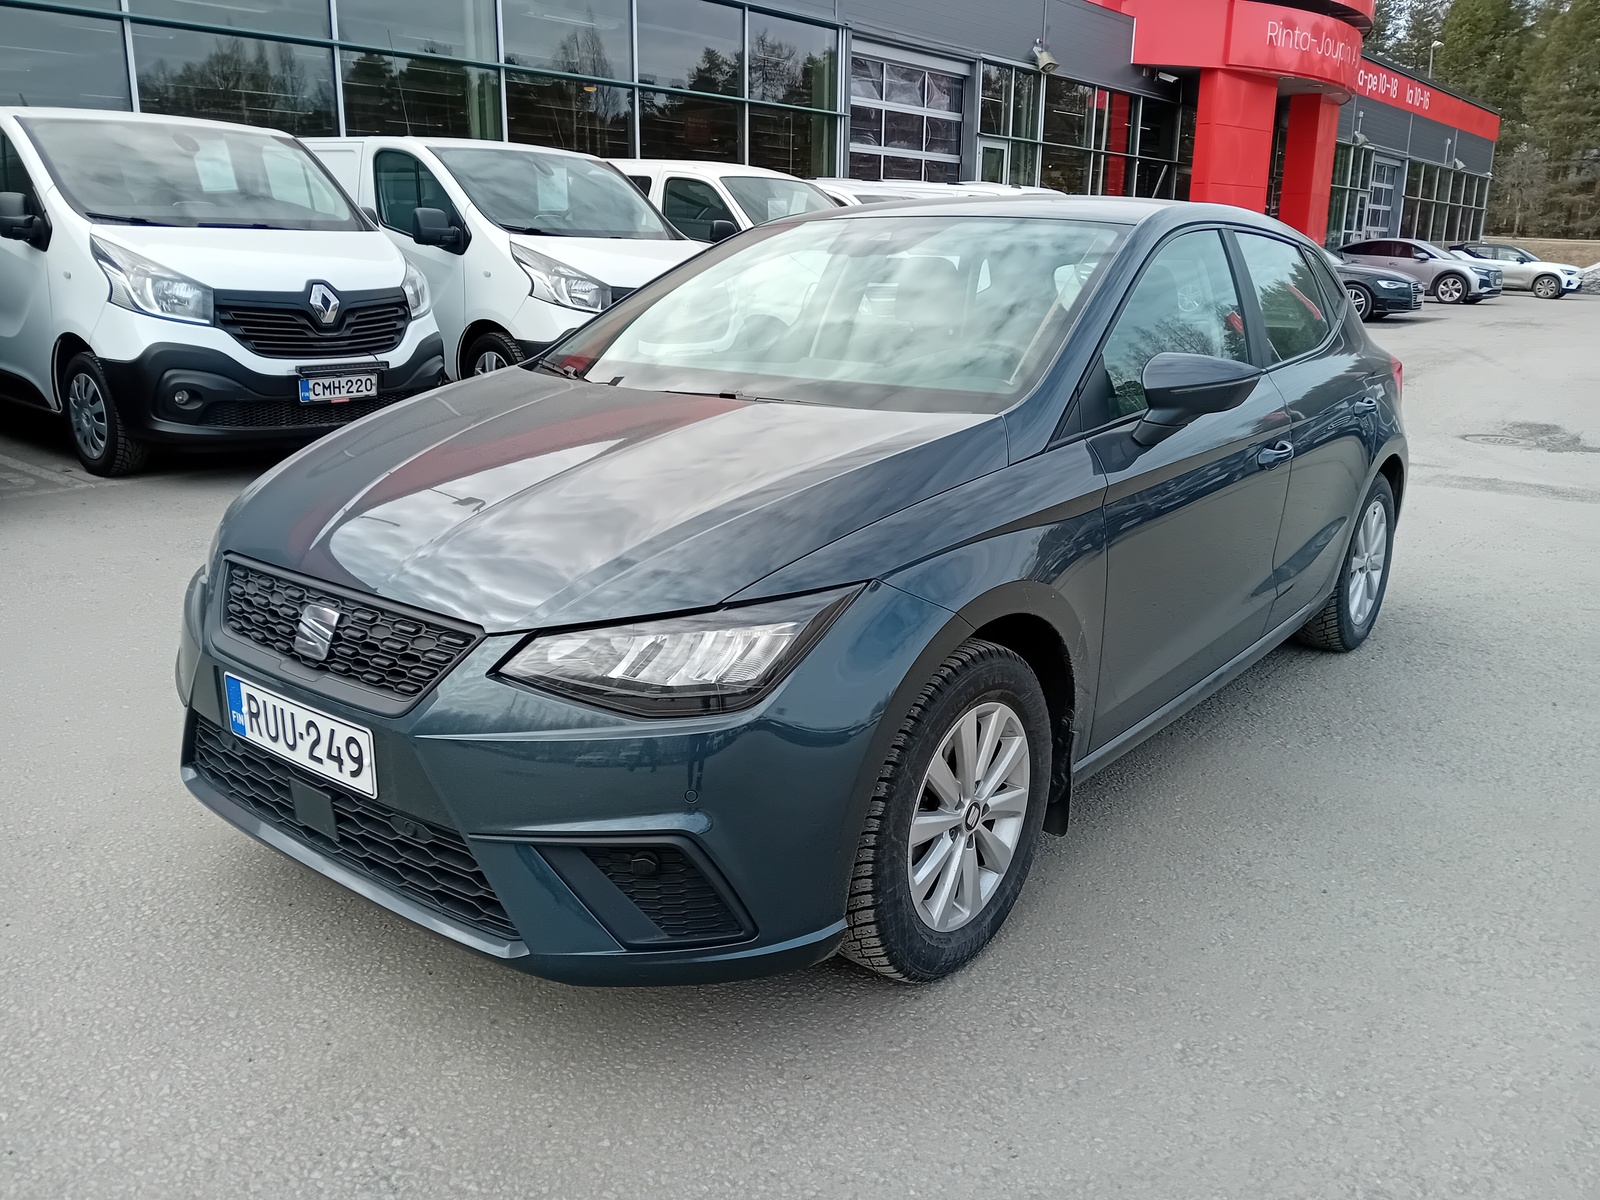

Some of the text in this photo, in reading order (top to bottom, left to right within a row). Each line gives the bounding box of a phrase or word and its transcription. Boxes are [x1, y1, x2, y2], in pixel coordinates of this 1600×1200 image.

[1358, 69, 1378, 95] a-pe
[1378, 72, 1398, 98] 10-18
[1414, 86, 1430, 110] 10-16
[312, 377, 373, 397] CMH-220
[232, 710, 245, 726] FIN
[246, 692, 364, 778] RUU-249
